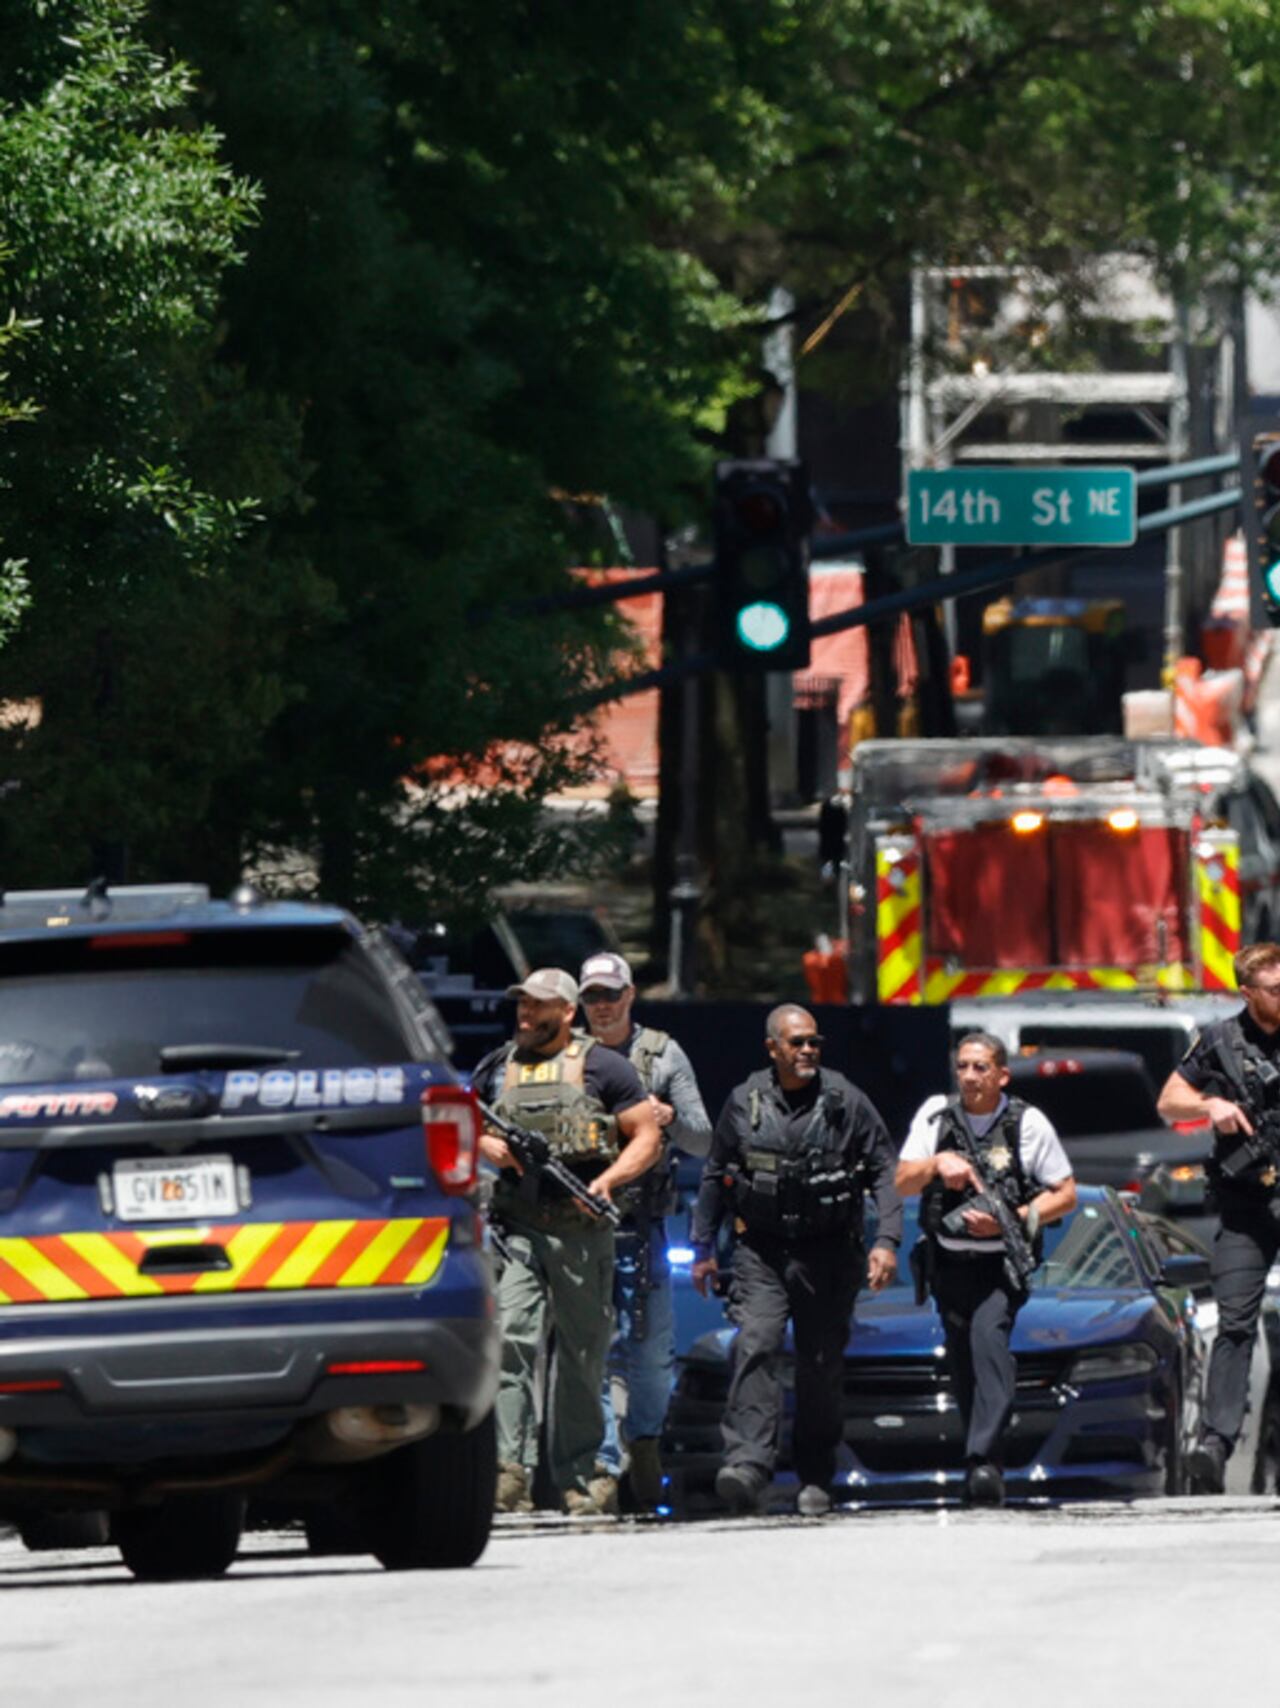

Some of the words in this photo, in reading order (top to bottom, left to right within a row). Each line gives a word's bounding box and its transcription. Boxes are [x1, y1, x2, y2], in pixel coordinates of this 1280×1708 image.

[919, 487, 1001, 525] 14th
[1031, 487, 1073, 526] St
[1087, 487, 1122, 516] NE
[221, 1068, 404, 1108] POLICE
[519, 1064, 561, 1083] FBI
